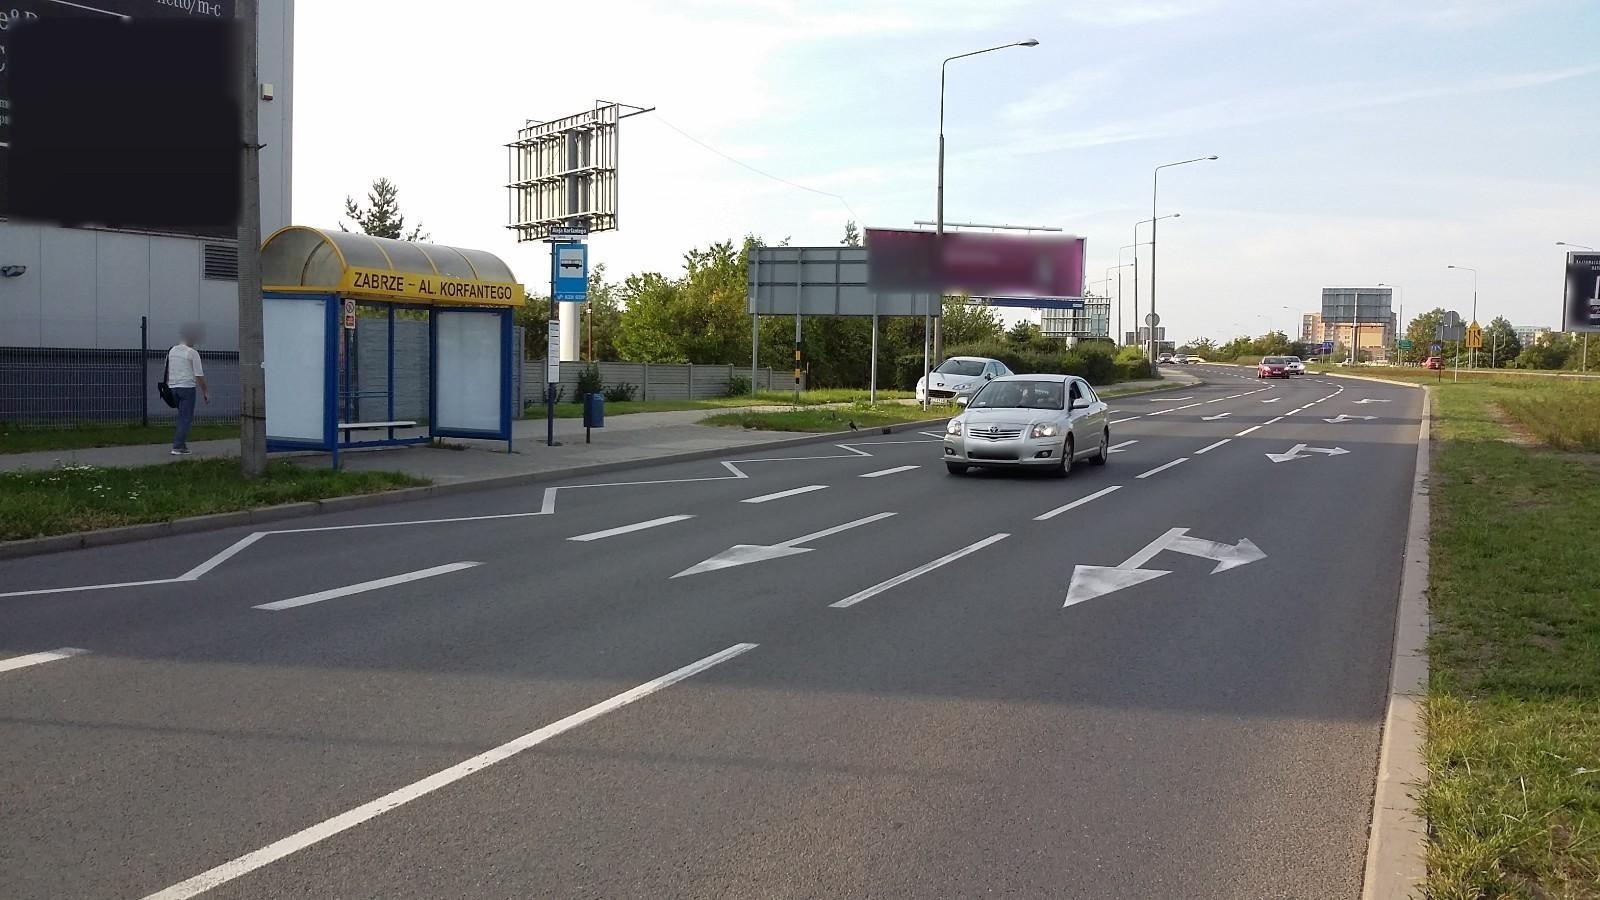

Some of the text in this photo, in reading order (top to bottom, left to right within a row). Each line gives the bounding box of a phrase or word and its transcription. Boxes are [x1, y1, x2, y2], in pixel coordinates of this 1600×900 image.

[157, 0, 220, 16] tto/m-c
[353, 272, 404, 291] ZABRZE
[418, 280, 437, 295] AL.
[440, 281, 512, 300] KORFANTEGO
